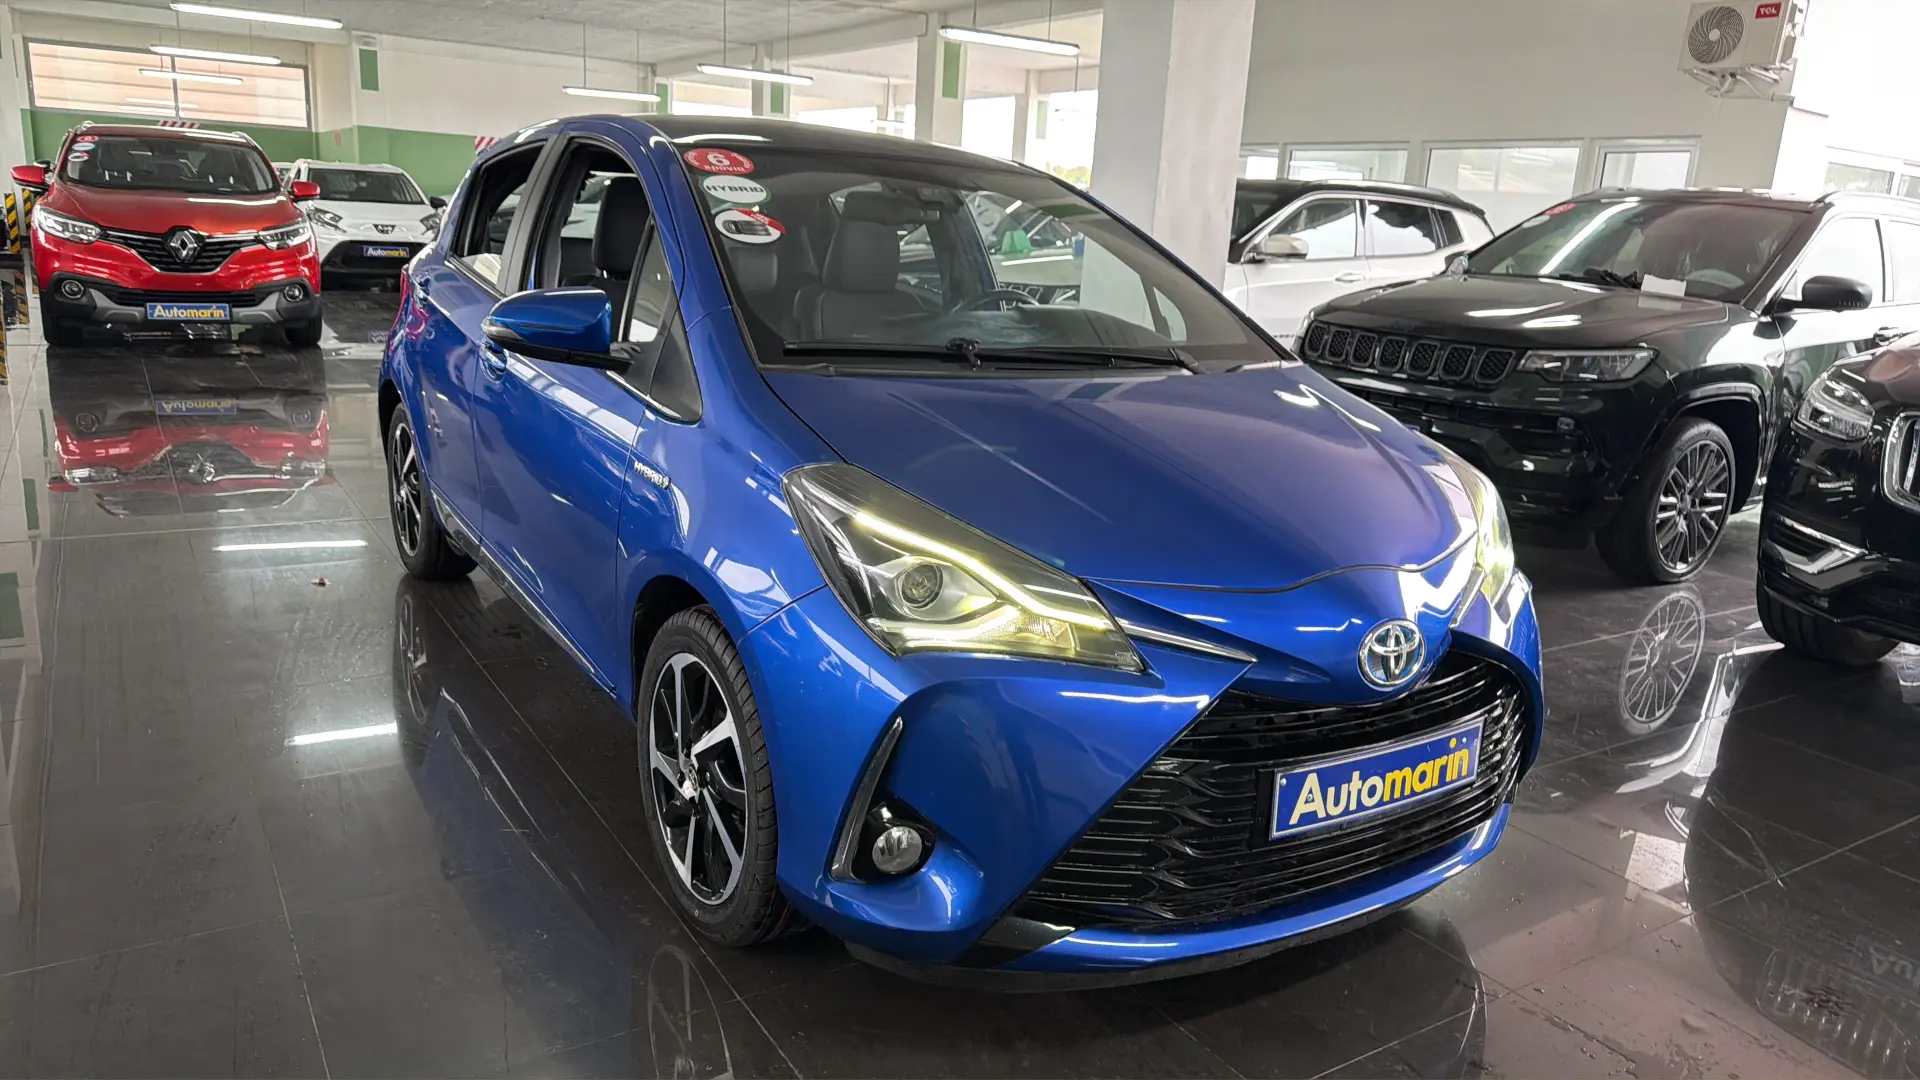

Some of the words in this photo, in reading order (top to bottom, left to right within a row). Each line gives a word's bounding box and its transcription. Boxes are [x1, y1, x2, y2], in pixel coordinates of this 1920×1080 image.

[1760, 6, 1777, 15] TCL
[706, 152, 731, 167] 6
[705, 184, 765, 193] HYBRID
[367, 247, 406, 256] Automarin
[154, 305, 225, 318] Automarin
[1289, 737, 1469, 825] Automarin
